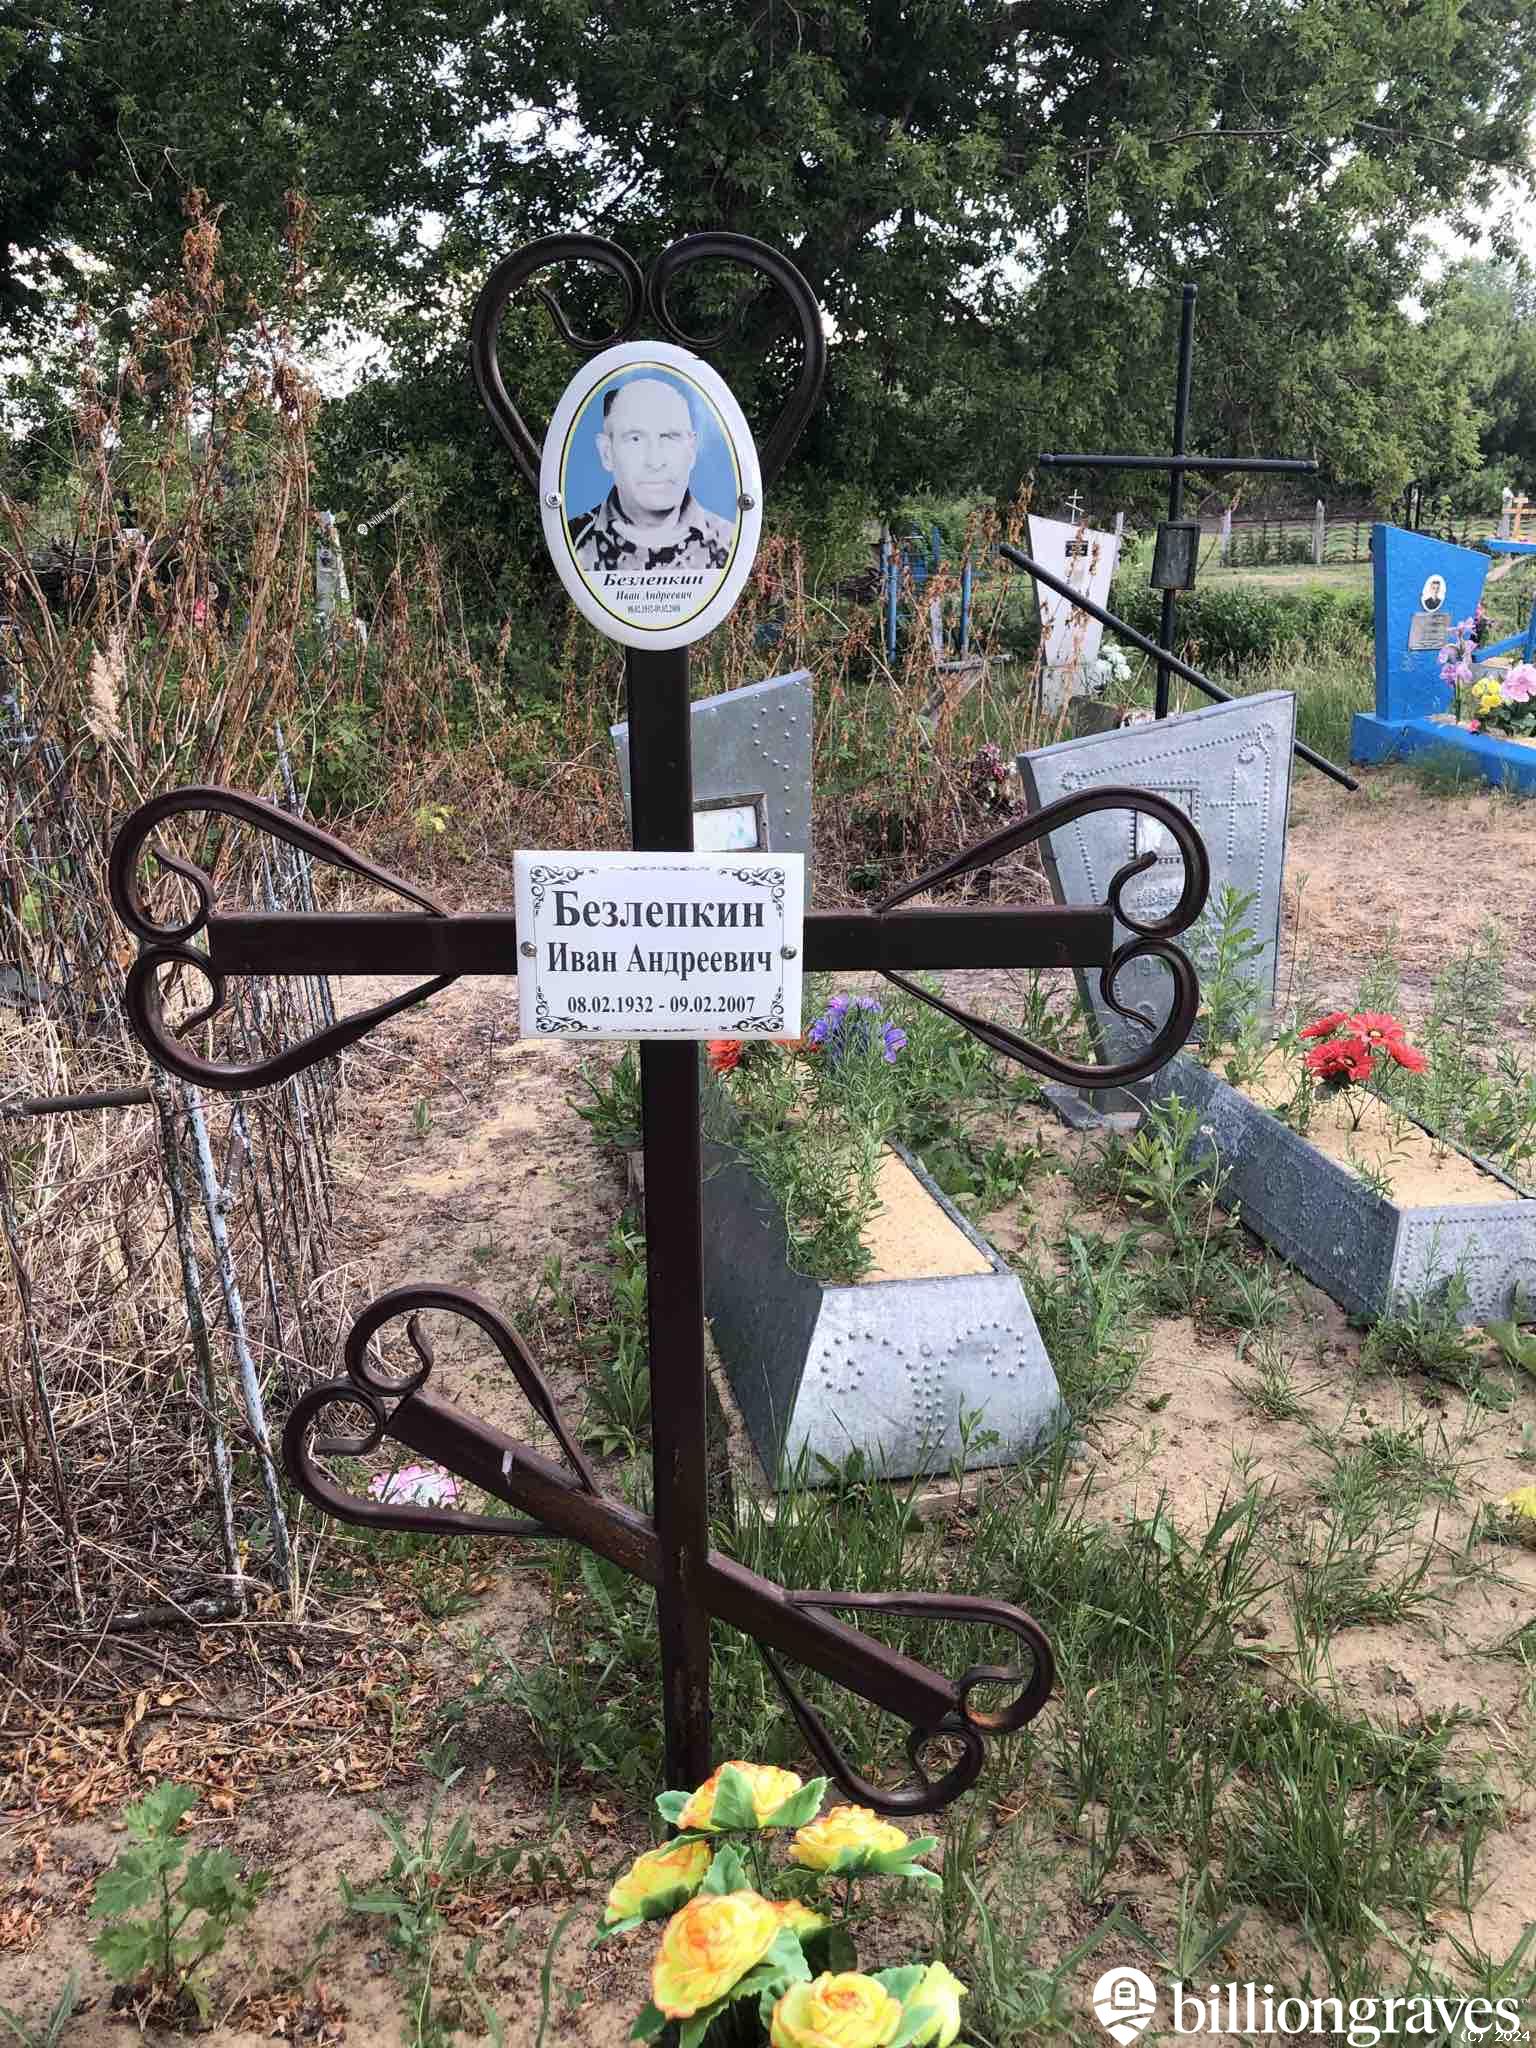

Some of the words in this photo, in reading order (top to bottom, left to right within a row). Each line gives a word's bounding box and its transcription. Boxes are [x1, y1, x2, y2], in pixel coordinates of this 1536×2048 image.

[603, 573, 704, 586] Безлепкин
[552, 890, 765, 928] Безлепкин
[547, 942, 617, 972] Иван
[626, 943, 772, 981] Андреевич
[567, 996, 653, 1013] 08.02.1932
[669, 996, 756, 1013] 09.02.2007
